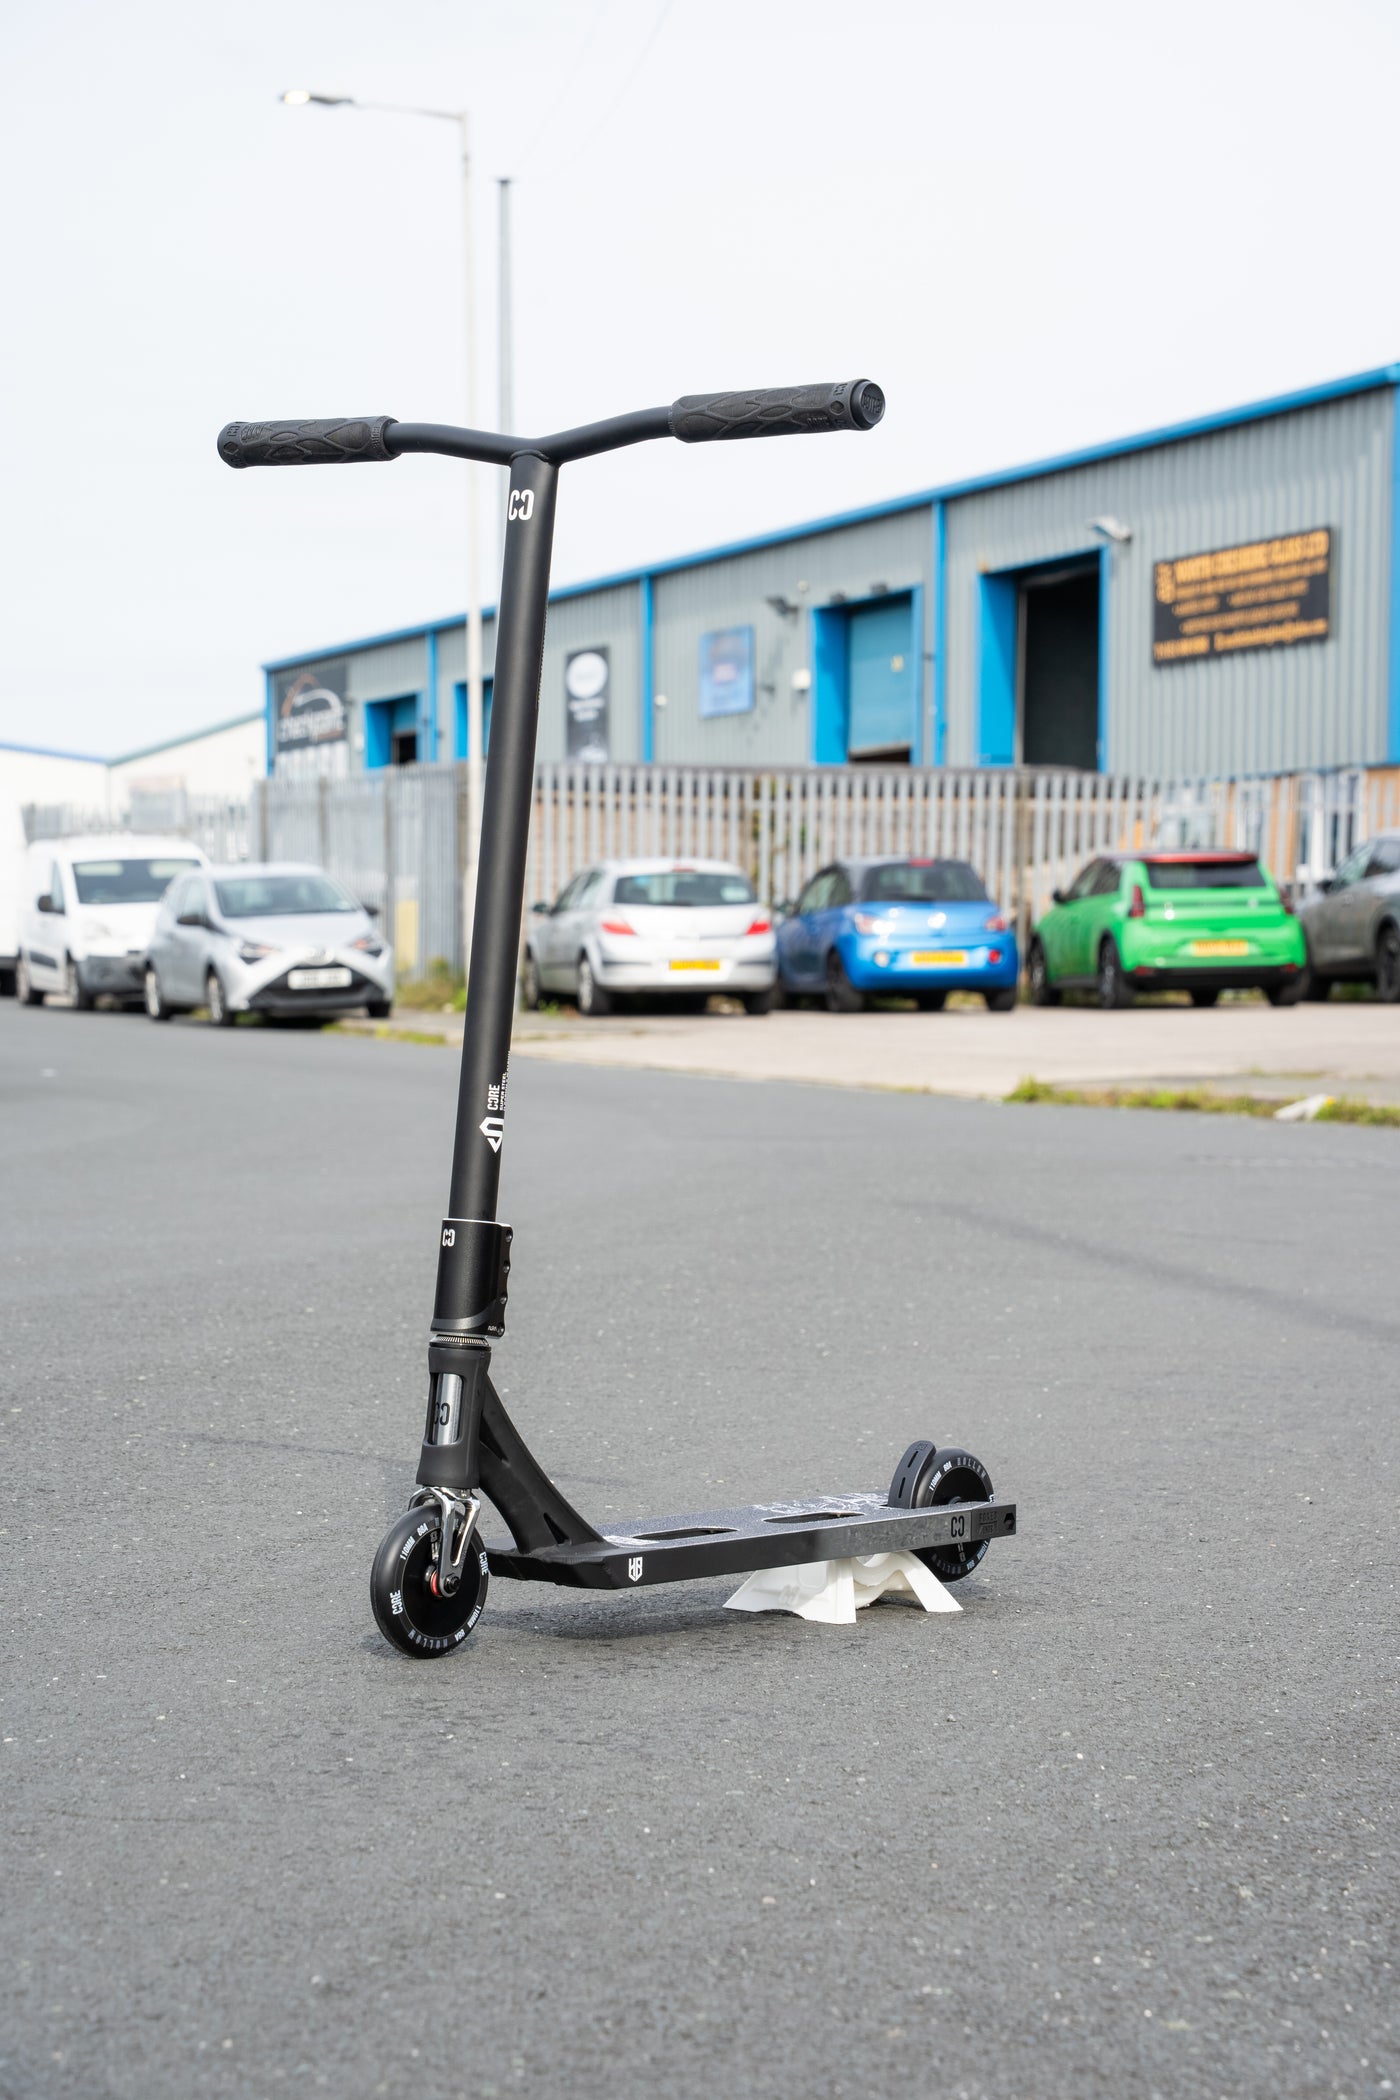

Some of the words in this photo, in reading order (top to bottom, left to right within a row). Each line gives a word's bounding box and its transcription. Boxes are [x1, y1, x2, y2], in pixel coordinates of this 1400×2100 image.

[487, 1083, 500, 1111] CORE
[399, 1535, 416, 1561] 110MM
[479, 1551, 490, 1576] CORE
[389, 1589, 404, 1616] CORE
[467, 1604, 482, 1629] 110MM
[407, 1628, 448, 1650] HOLLOW
